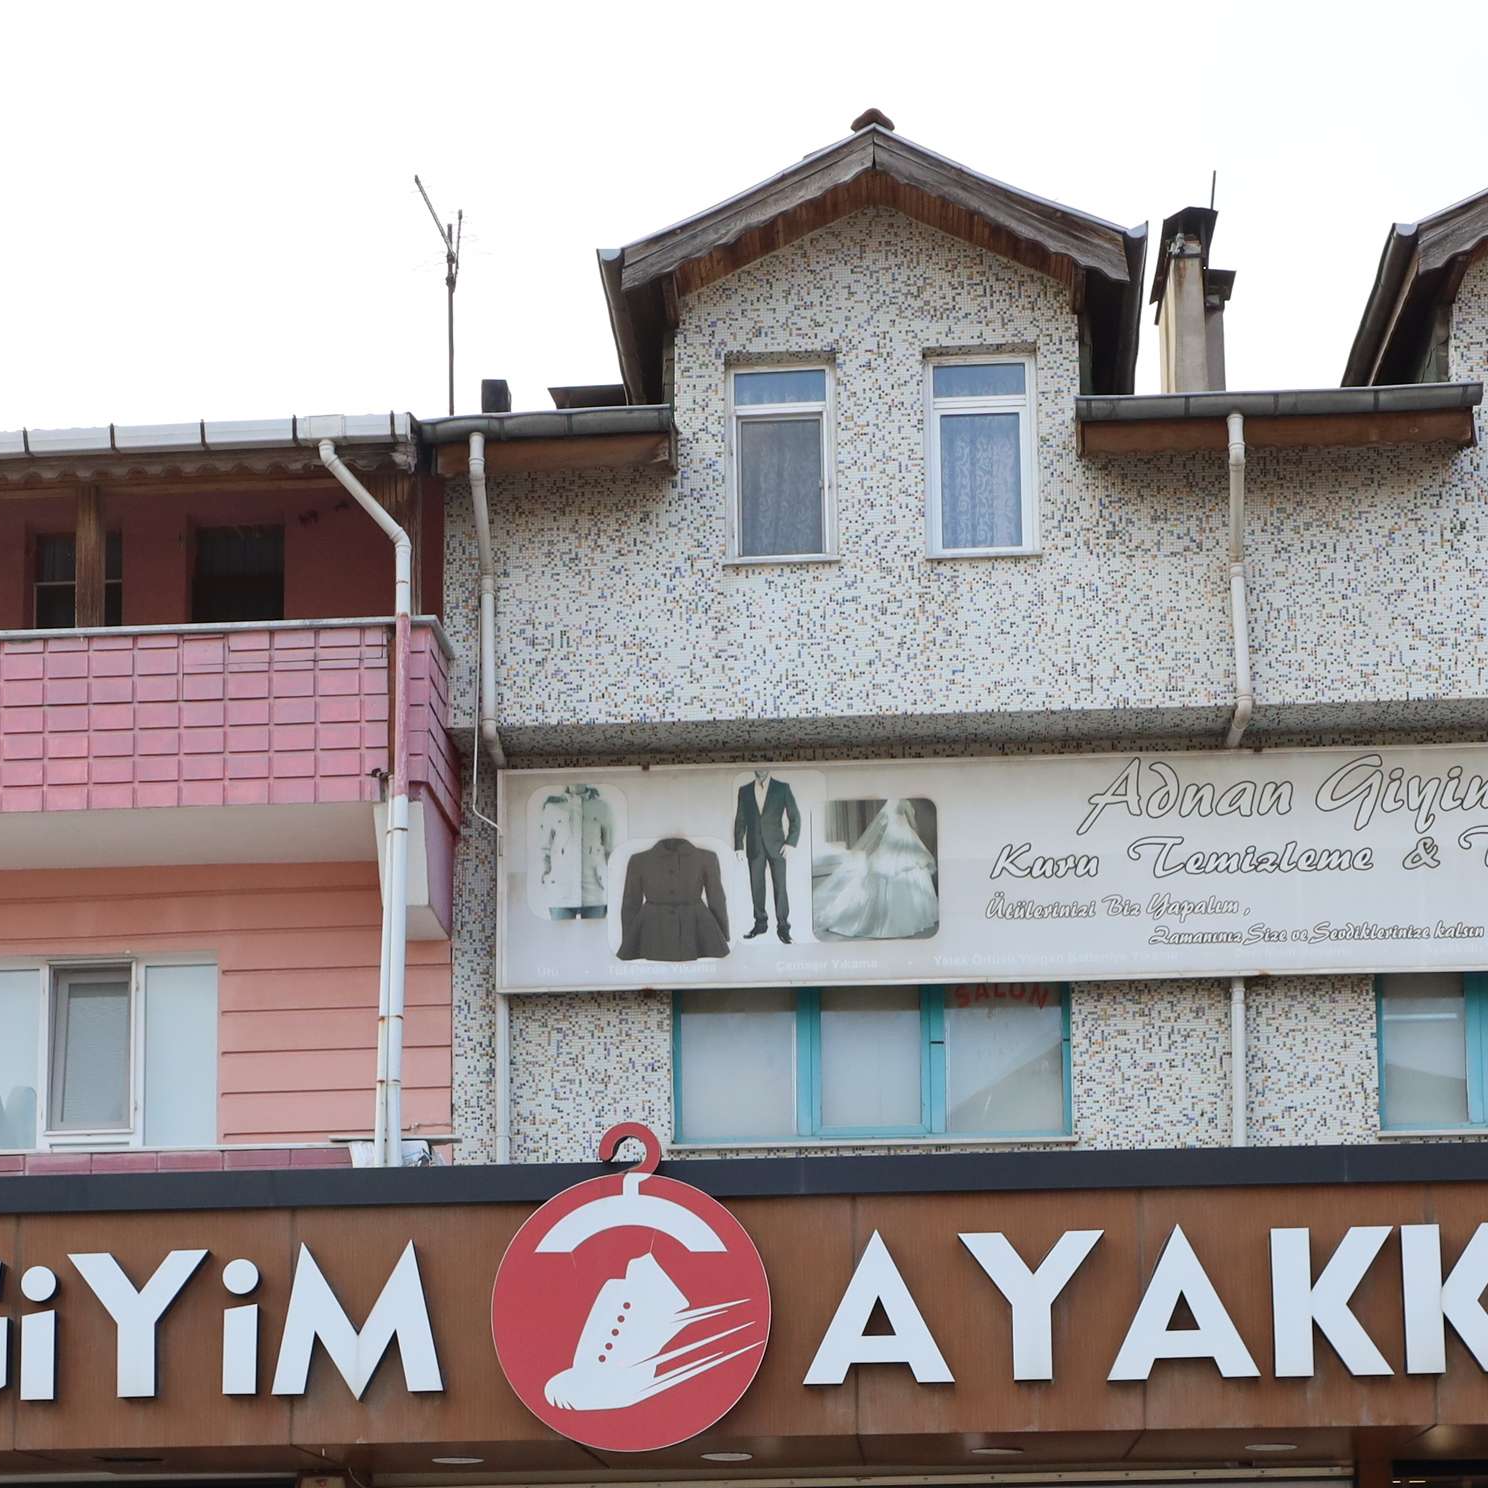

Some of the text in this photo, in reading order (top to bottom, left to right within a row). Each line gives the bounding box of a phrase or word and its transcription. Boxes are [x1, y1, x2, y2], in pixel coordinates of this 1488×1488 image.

[1075, 756, 1294, 835] Adnan
[989, 842, 1100, 880] Kuru
[1127, 835, 1375, 879] Temizleme
[1402, 836, 1440, 871] &
[985, 891, 1097, 920] Ütülerinizi
[1101, 895, 1141, 919] Biz
[1290, 929, 1309, 943] ve
[1308, 921, 1430, 945] Sevdiklerinize
[1432, 920, 1486, 941] kalsın
